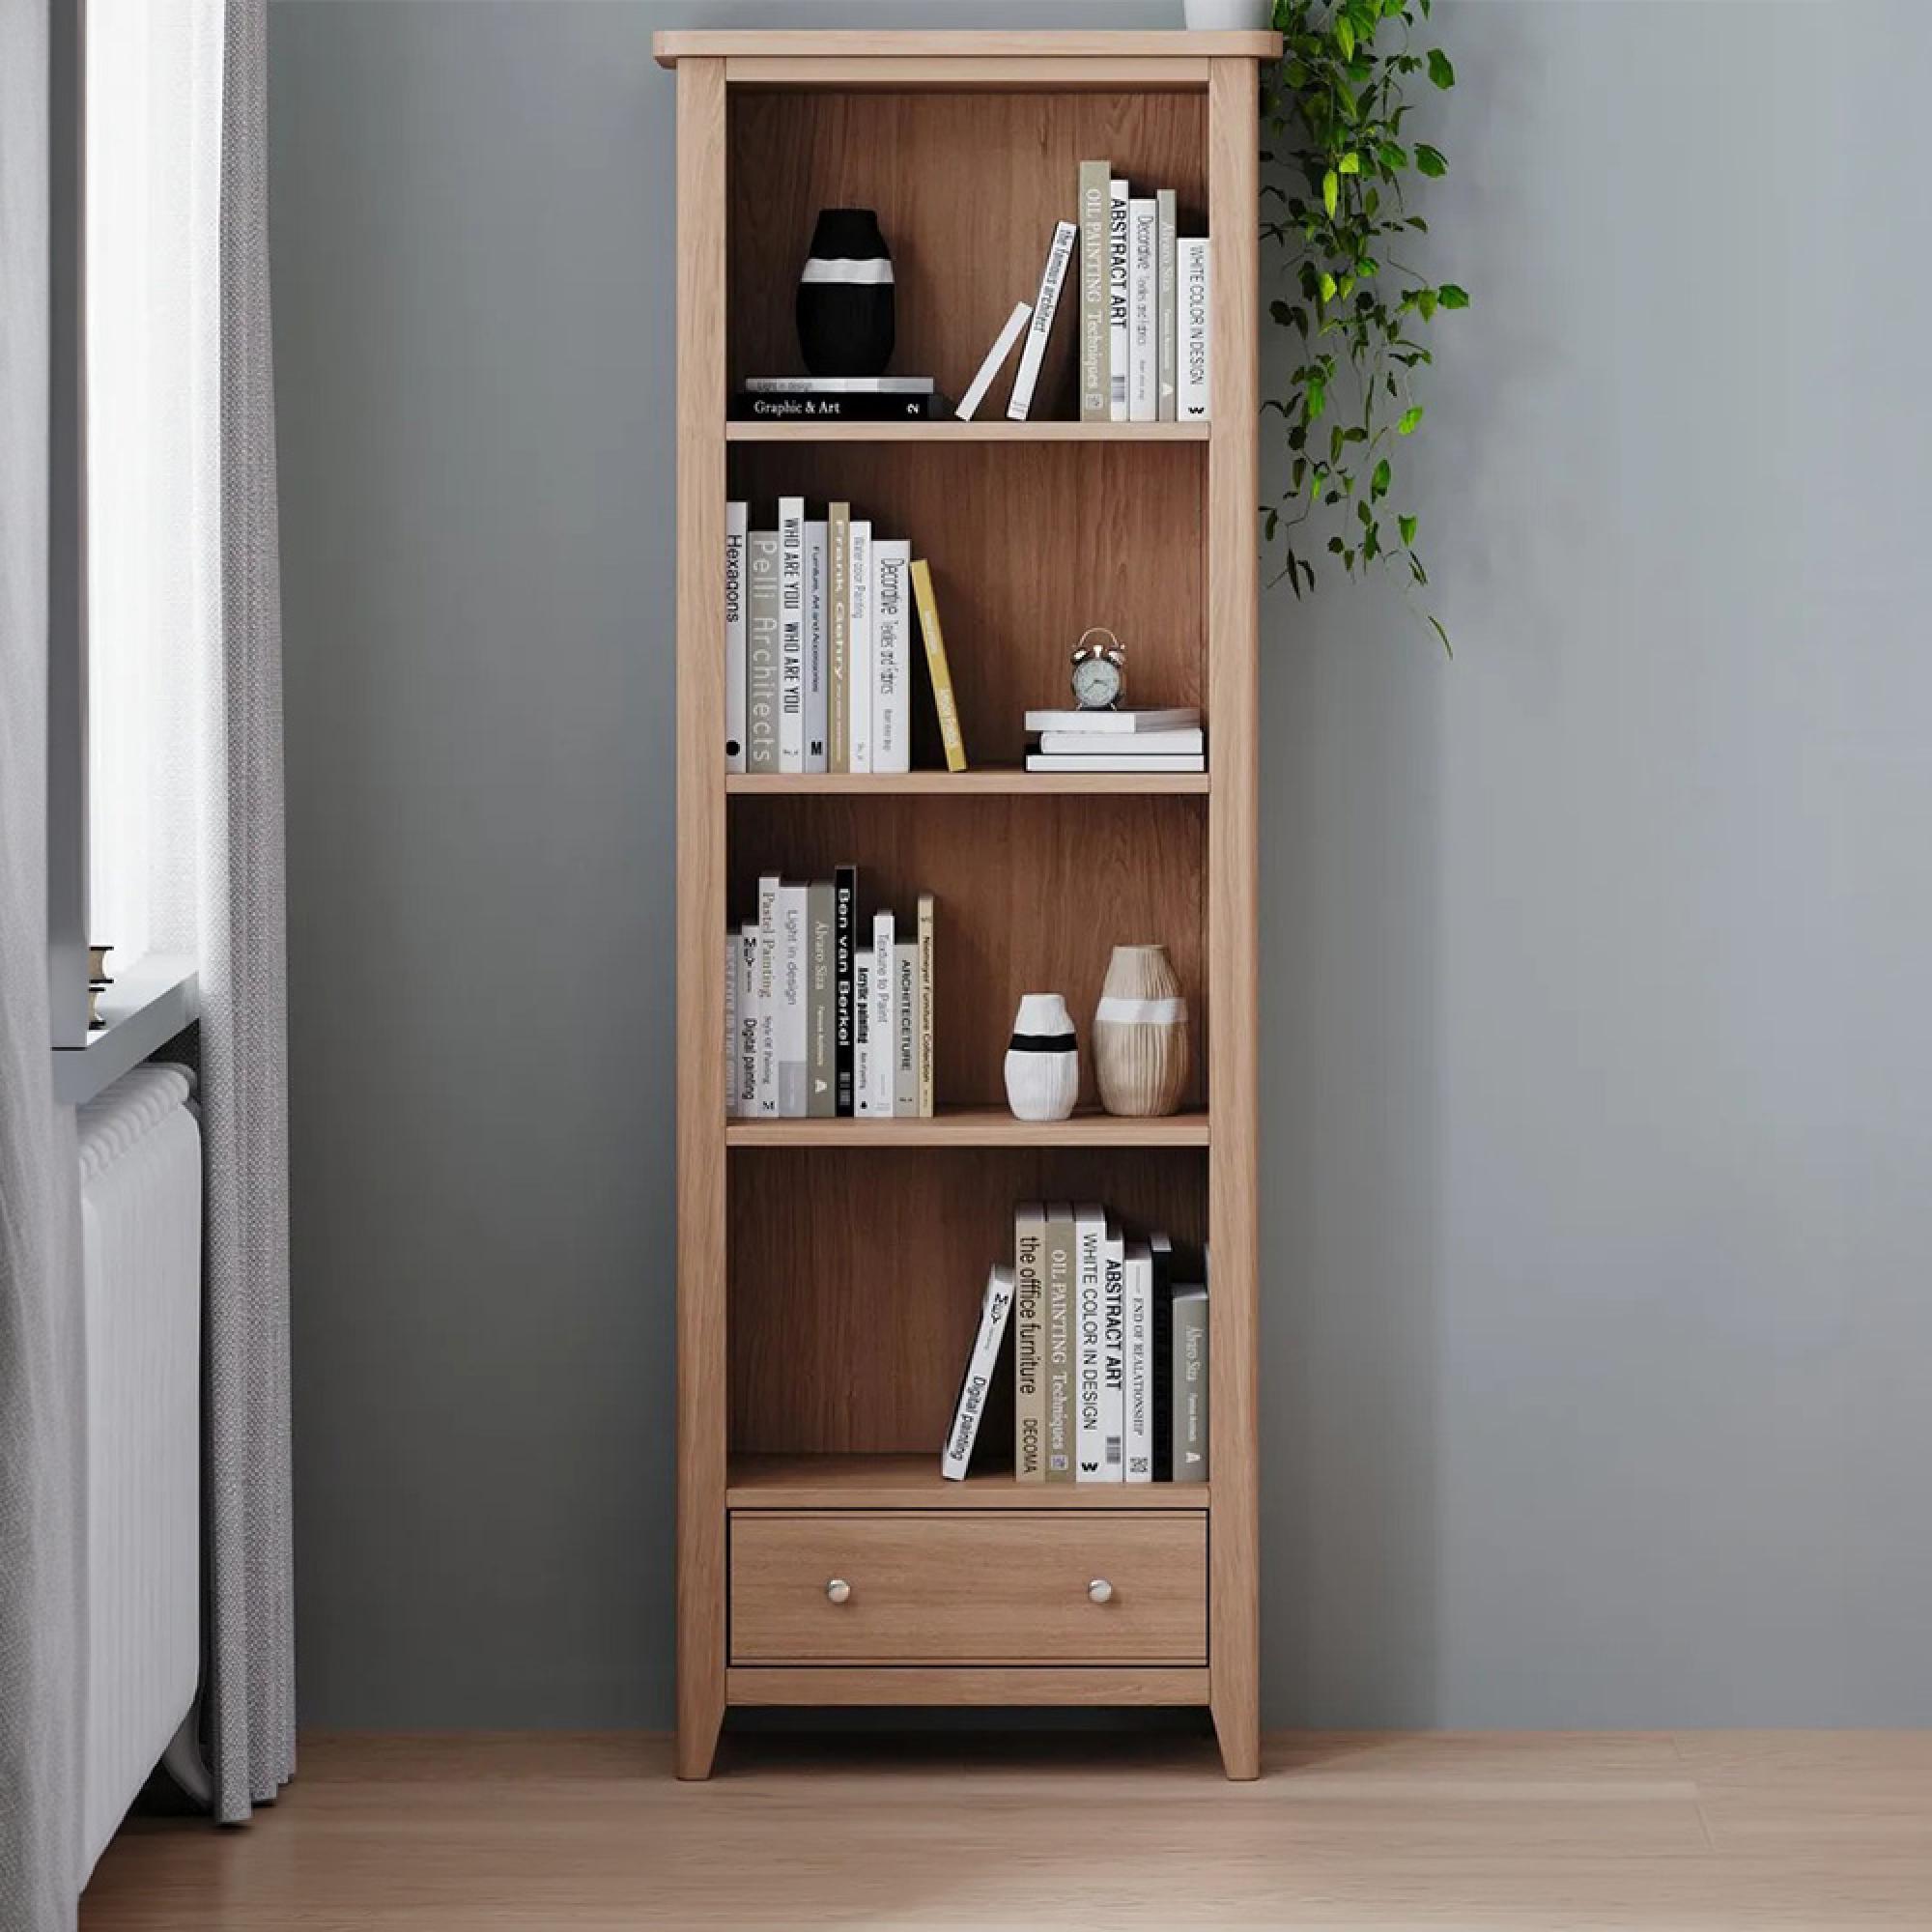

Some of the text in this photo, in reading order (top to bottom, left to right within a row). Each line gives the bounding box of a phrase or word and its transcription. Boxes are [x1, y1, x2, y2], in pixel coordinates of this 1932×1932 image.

[1111, 198, 1127, 329] ABSTRACT ART
[1137, 214, 1154, 270] Decorative
[1084, 187, 1103, 388] OIL PAINTING Techniques
[1189, 245, 1205, 385] WHITE COLOR IN DESIGN
[753, 400, 841, 417] Graphic & Art
[783, 518, 801, 714] WHO ARE YOU WHO ARE YOU
[880, 557, 906, 615] Decorative
[753, 539, 778, 762] Pelli Architects
[758, 892, 776, 998] Pastel Painting
[784, 909, 800, 1006] Light in design
[877, 933, 890, 1022] Texture to Paint
[742, 1056, 757, 1099] painting
[1020, 1236, 1041, 1264] the
[1049, 1249, 1068, 1449] OIL PAINTING Techniques
[1083, 1233, 1098, 1431] WHITE COLOR IN DESIGN
[1105, 1259, 1122, 1391] ABSTRACT ART
[1133, 1297, 1145, 1322] END
[1133, 1324, 1145, 1339] OF
[1020, 1322, 1041, 1394] furniture
[950, 1376, 987, 1461] Digital painting
[1023, 1418, 1038, 1474] DECOMA
